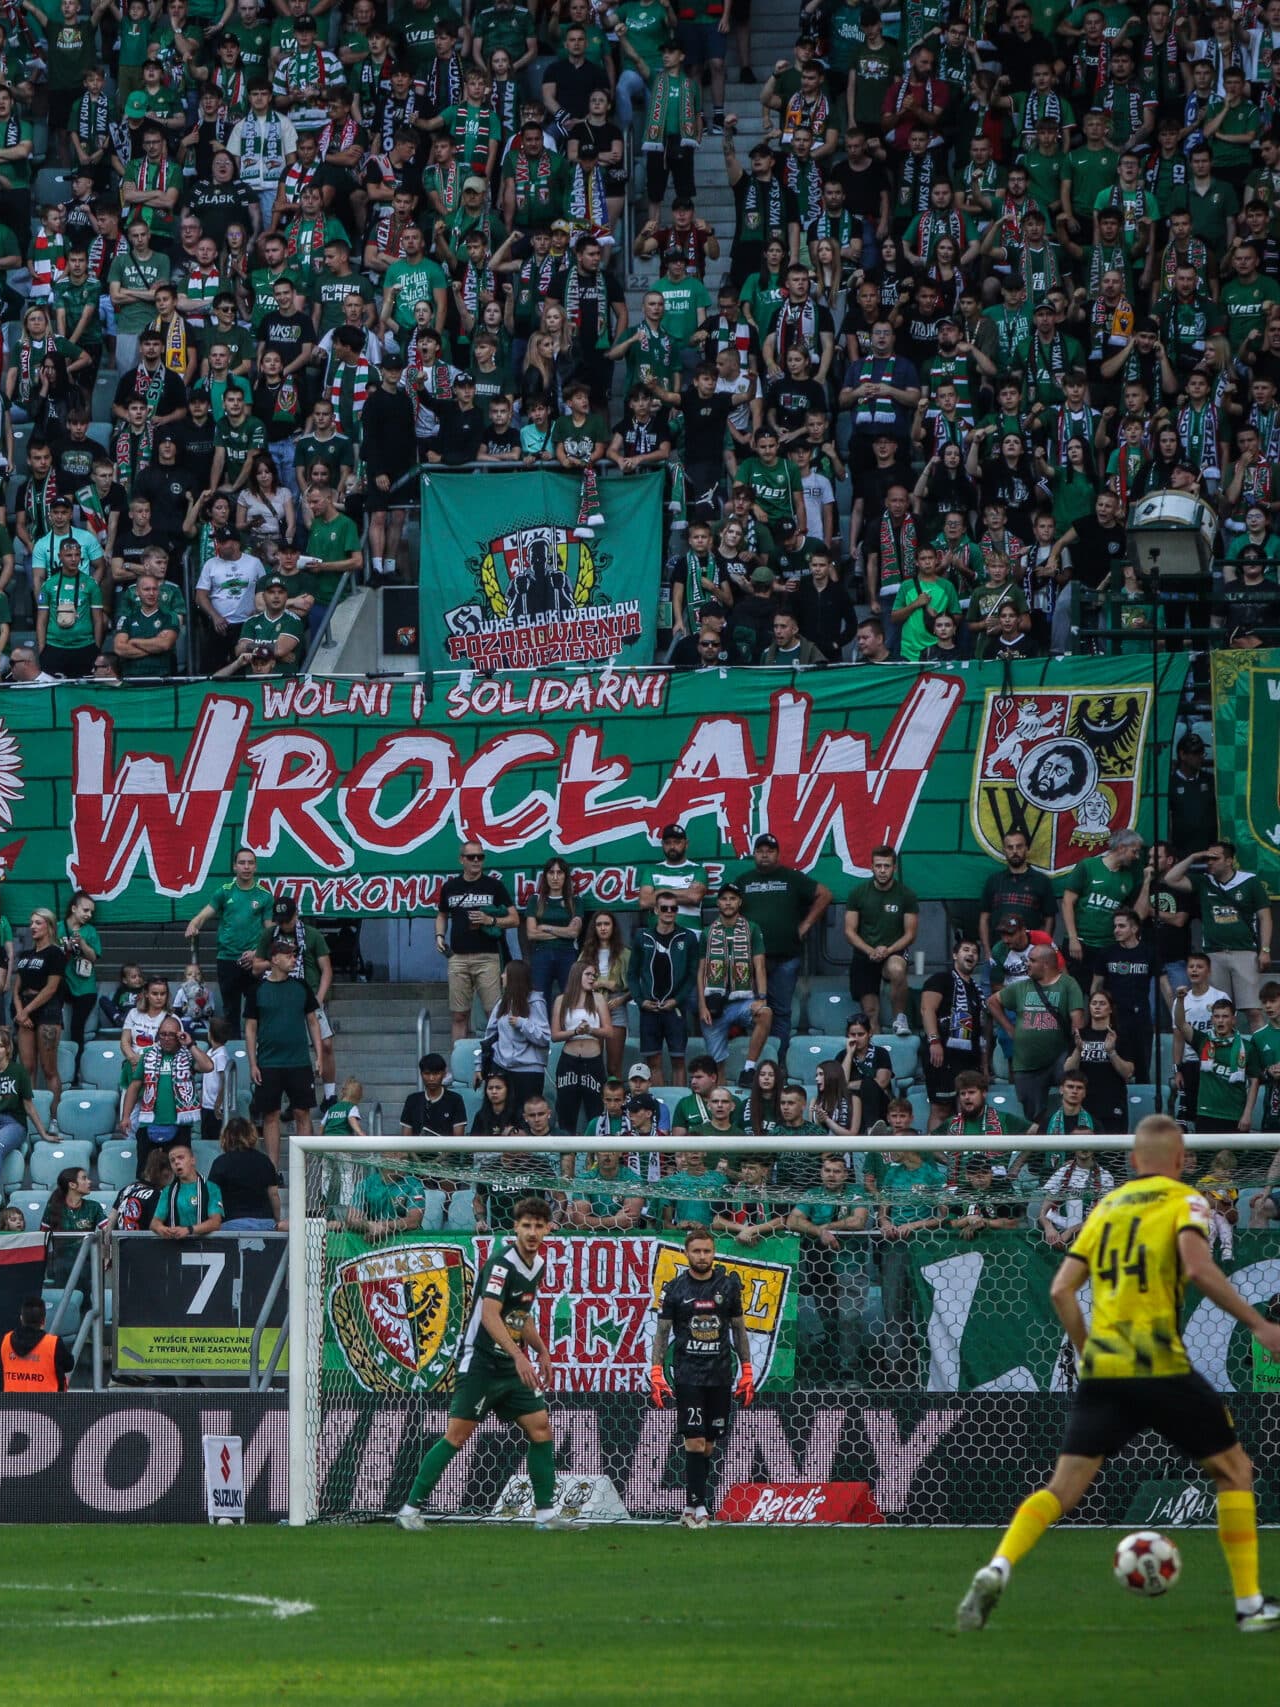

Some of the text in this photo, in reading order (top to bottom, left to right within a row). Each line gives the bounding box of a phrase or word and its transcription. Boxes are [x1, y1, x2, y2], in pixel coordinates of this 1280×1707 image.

[629, 276, 649, 288] 22
[449, 612, 641, 661] POZDROWIENIA
[262, 672, 669, 720] WOLNI I SOLIDARNI
[66, 673, 966, 901] WROCŁAW
[571, 863, 724, 904] POLE
[1088, 892, 1120, 909] LVBE
[1098, 1216, 1149, 1293] 44
[472, 1236, 655, 1294] GION
[181, 1252, 226, 1314] 7
[153, 1333, 251, 1344] WYJŚCIE EWAKUACYJNE
[686, 1340, 721, 1351] LVBET
[156, 1346, 190, 1354] TRYBUN,
[192, 1345, 206, 1353] NIE
[6, 1371, 45, 1382] TEWARD
[474, 1396, 486, 1415] 4
[687, 1407, 703, 1426] 25
[213, 1489, 243, 1507] SUZUKI
[748, 1486, 827, 1521] Betclic
